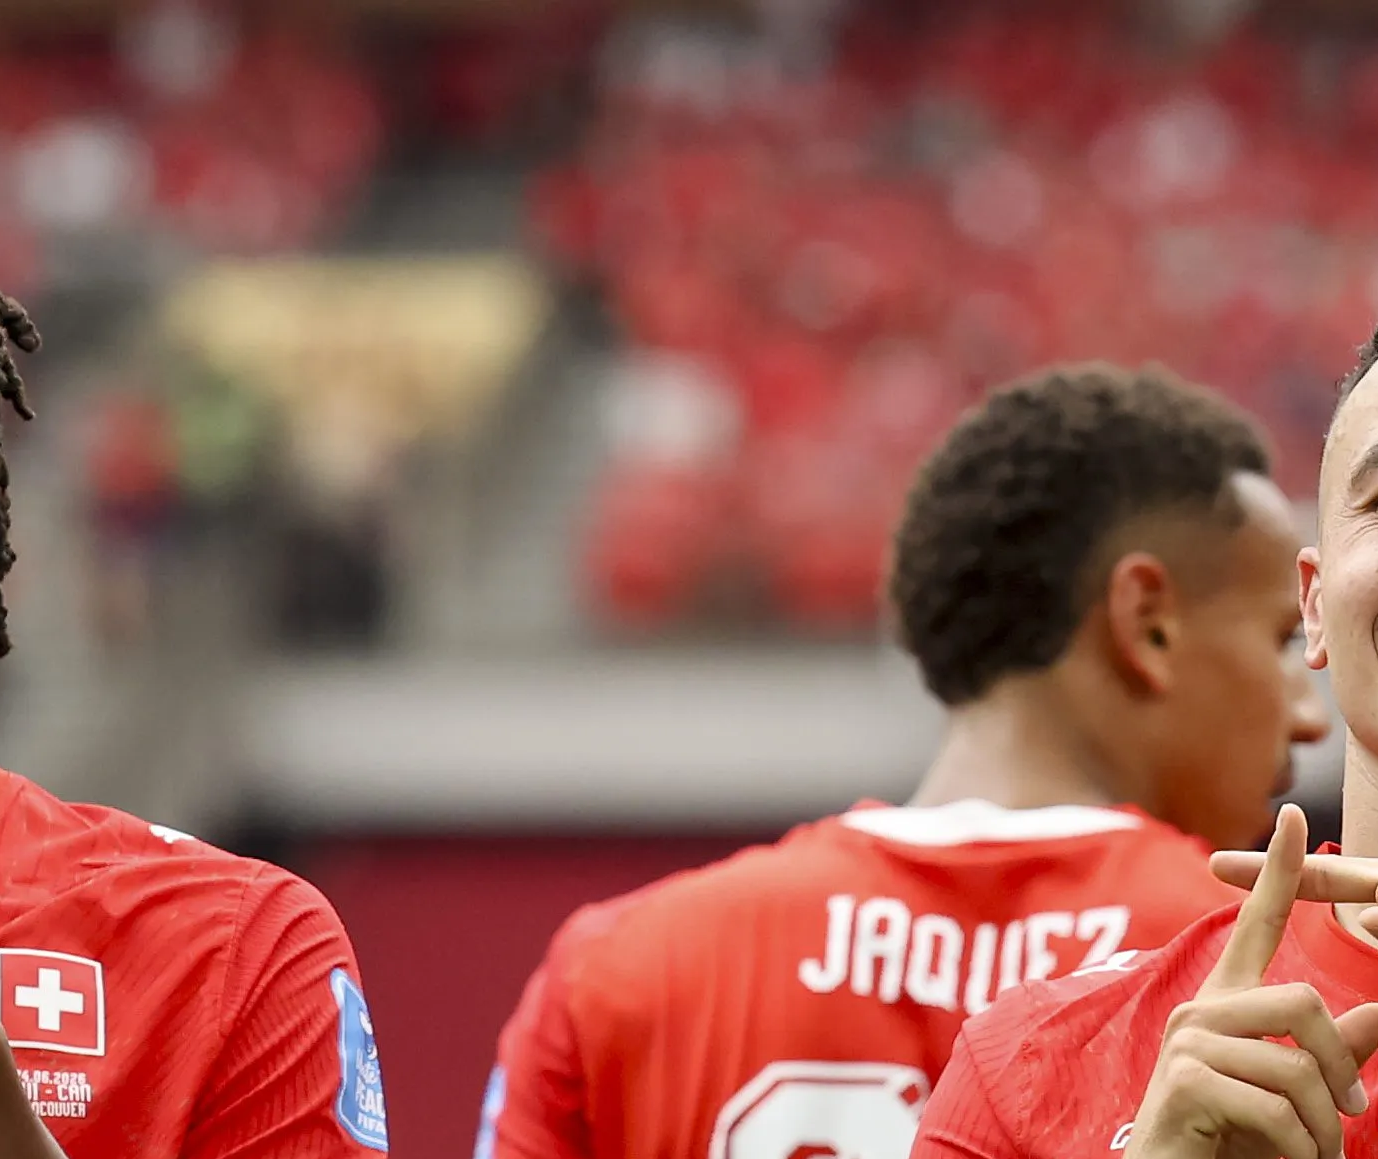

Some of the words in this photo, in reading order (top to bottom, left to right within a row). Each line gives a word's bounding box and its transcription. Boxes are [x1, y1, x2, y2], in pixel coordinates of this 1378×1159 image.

[798, 893, 1131, 1017] JAQUEZ
[16, 1068, 87, 1085] 4.06.2026
[57, 1083, 92, 1102] CAN
[31, 1101, 87, 1118] NCOUVER
